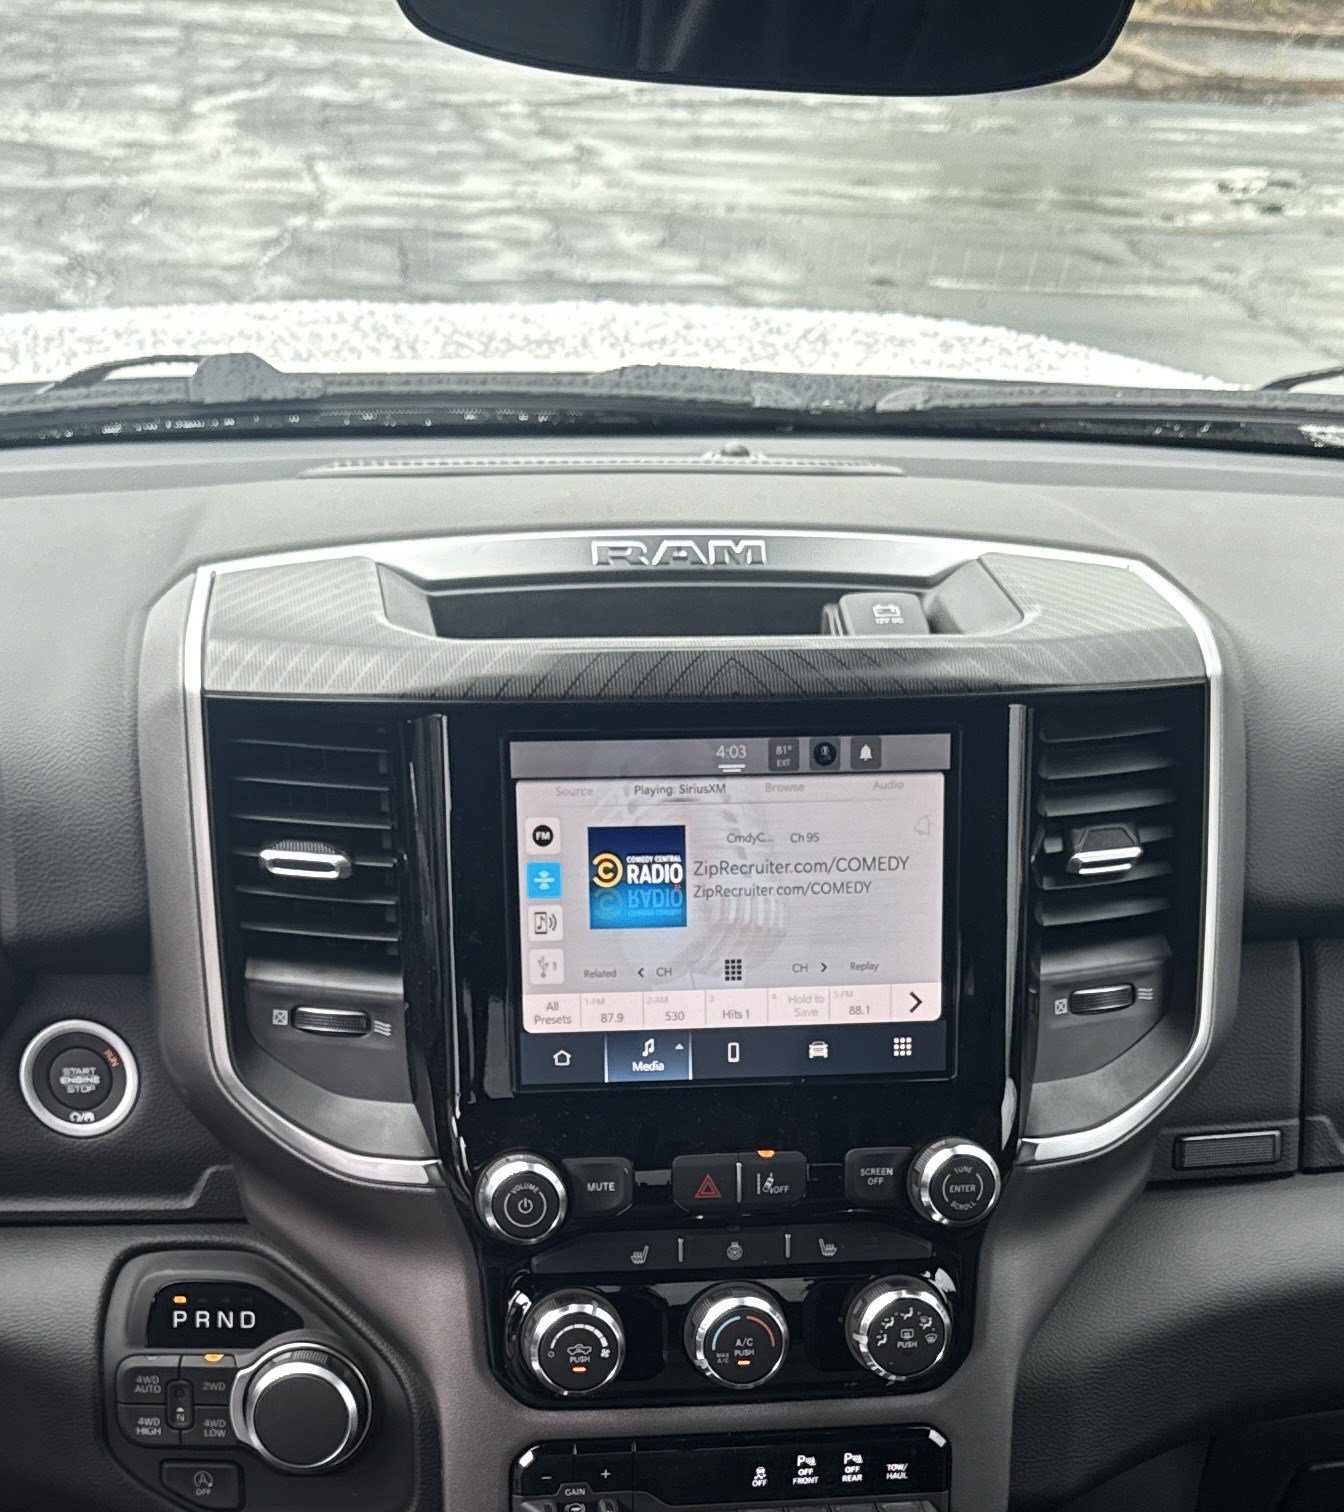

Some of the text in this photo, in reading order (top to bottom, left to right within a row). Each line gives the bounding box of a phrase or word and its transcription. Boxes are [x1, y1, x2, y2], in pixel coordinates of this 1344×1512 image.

[591, 539, 767, 566] RAM
[715, 744, 747, 760] 4:03
[633, 783, 726, 797] Playing: SiriusXM
[765, 782, 805, 793] Browse
[873, 779, 905, 791] Audio
[535, 830, 553, 842] FM
[807, 833, 820, 843] 95
[694, 856, 910, 877] ZipRecruiter.com/COMEDY
[627, 863, 683, 884] RADIO
[694, 881, 872, 899] ZipRecruiter.com/COMEDY
[656, 967, 673, 977] CH
[792, 963, 808, 973] CH
[850, 961, 879, 973] Replay
[584, 969, 617, 979] Related
[601, 1013, 624, 1024] 87.9
[665, 1011, 685, 1022] 530
[723, 1009, 743, 1020] Hits
[632, 1060, 665, 1072] Media
[860, 1167, 894, 1177] SCREEN
[587, 1181, 616, 1192] MUTE
[867, 1177, 884, 1186] OFF
[773, 1185, 790, 1194] OFF
[949, 1184, 976, 1194] ENTER
[735, 1337, 754, 1347] A/C
[734, 1348, 755, 1357] PUSH
[569, 1355, 591, 1364] PUSH
[136, 1375, 160, 1385] 4WD
[203, 1381, 226, 1391] 2WD
[137, 1417, 161, 1427] 4WD
[203, 1419, 227, 1428] 4WD
[136, 1427, 162, 1436] HIGH
[203, 1428, 226, 1438] LOW
[797, 1468, 814, 1477] OFF
[844, 1465, 861, 1474] OFF
[792, 1476, 819, 1485] FRONT
[841, 1473, 863, 1483] REAR
[886, 1472, 908, 1480] HAUL
[752, 1478, 768, 1488] OFF
[564, 1488, 586, 1497] GAIN
